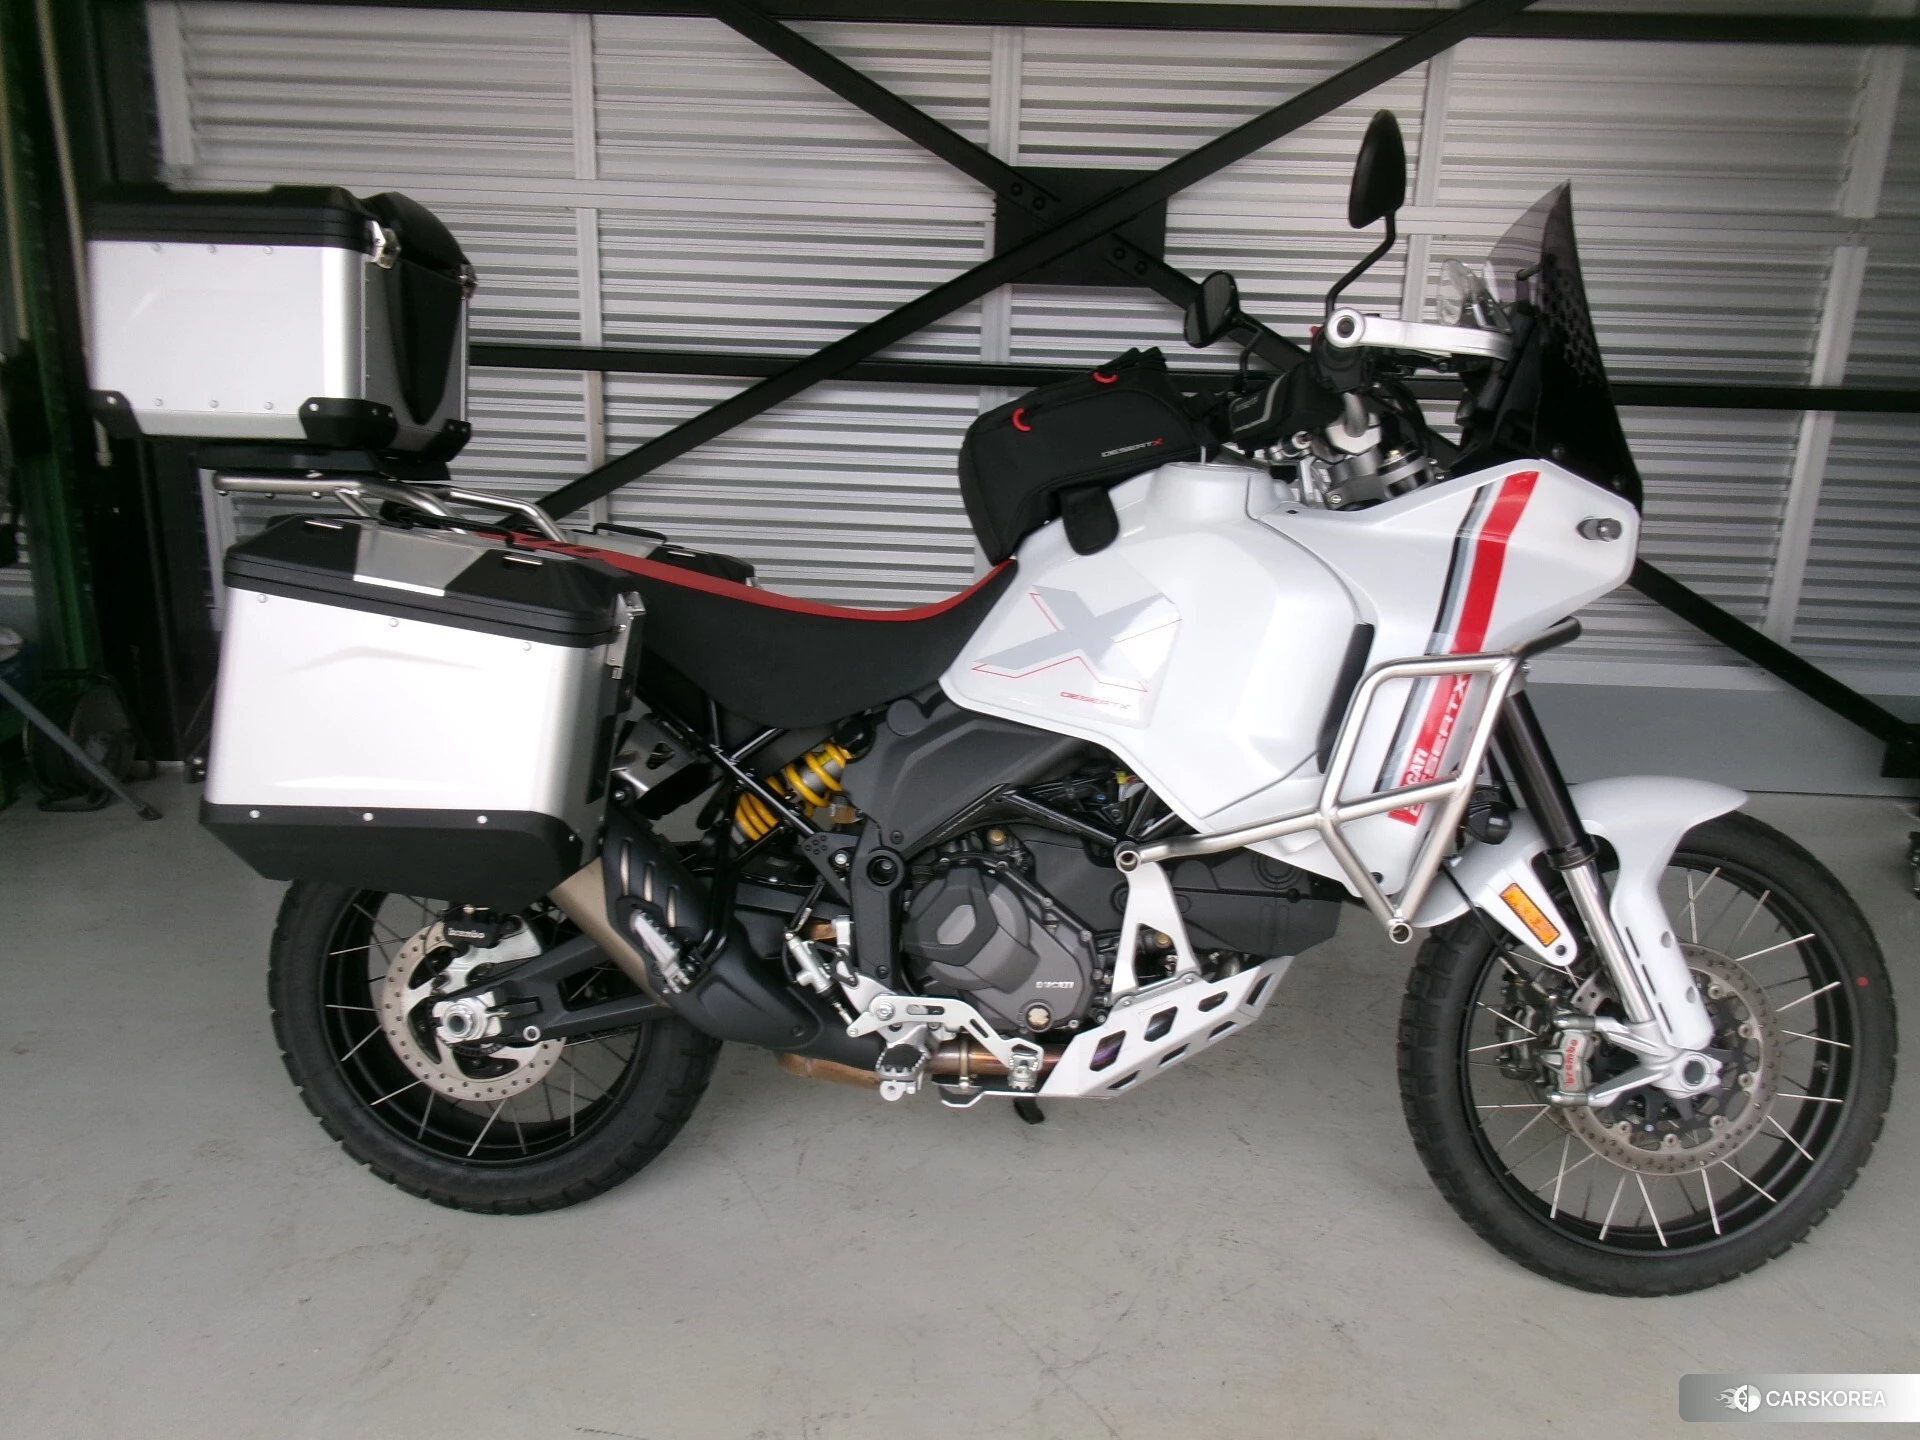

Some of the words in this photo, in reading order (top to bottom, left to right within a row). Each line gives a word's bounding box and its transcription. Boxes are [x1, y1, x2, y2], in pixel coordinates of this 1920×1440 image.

[1409, 673, 1468, 817] DSERTX
[1035, 980, 1075, 989] DUCATI
[1564, 1039, 1579, 1086] brembo
